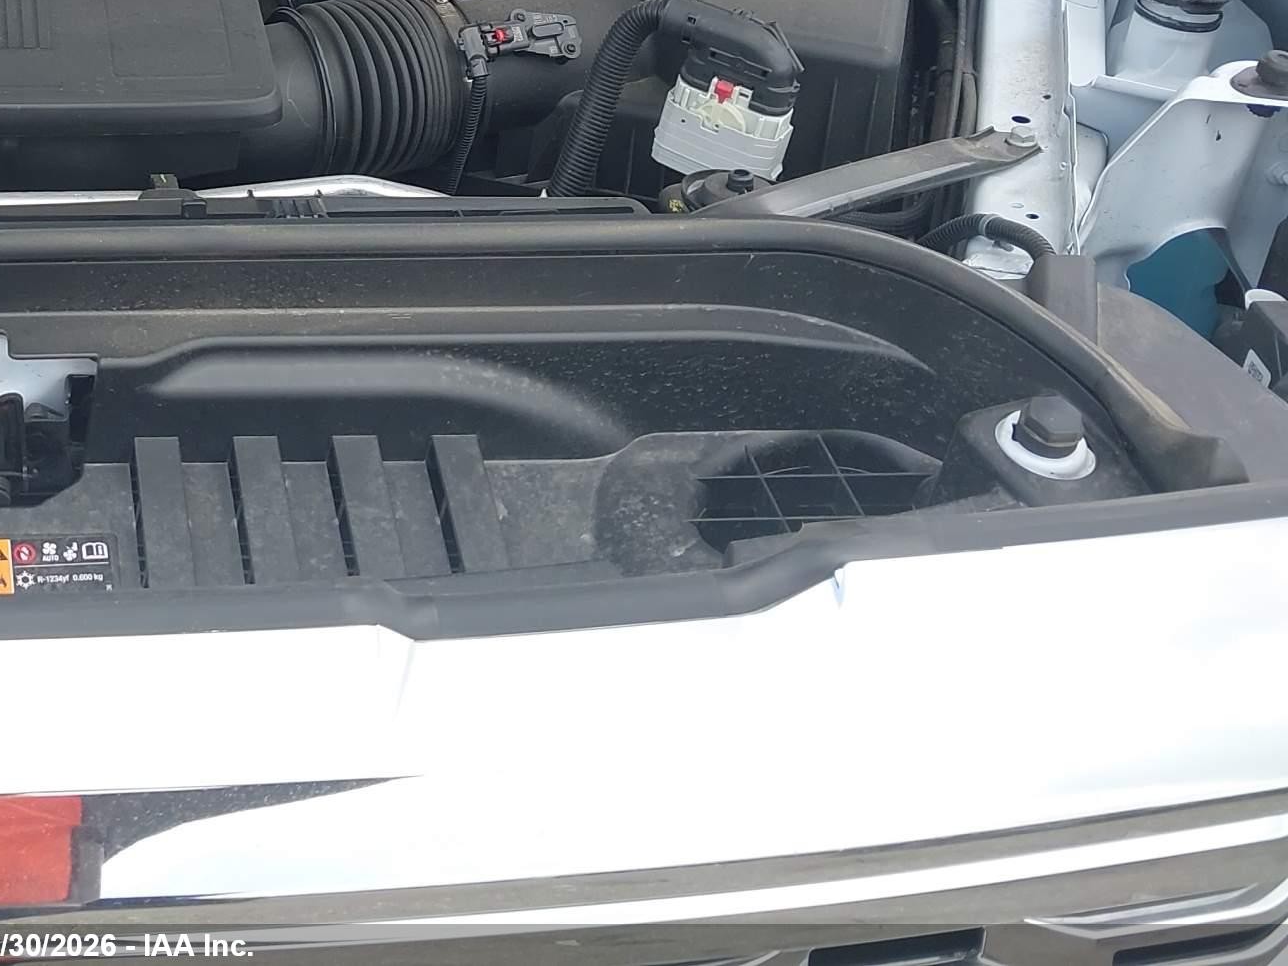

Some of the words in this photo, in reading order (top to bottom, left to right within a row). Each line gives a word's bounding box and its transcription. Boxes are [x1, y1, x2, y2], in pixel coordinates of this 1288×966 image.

[42, 554, 60, 562] AUTO
[36, 574, 70, 584] R-1234yf
[93, 573, 104, 582] kg
